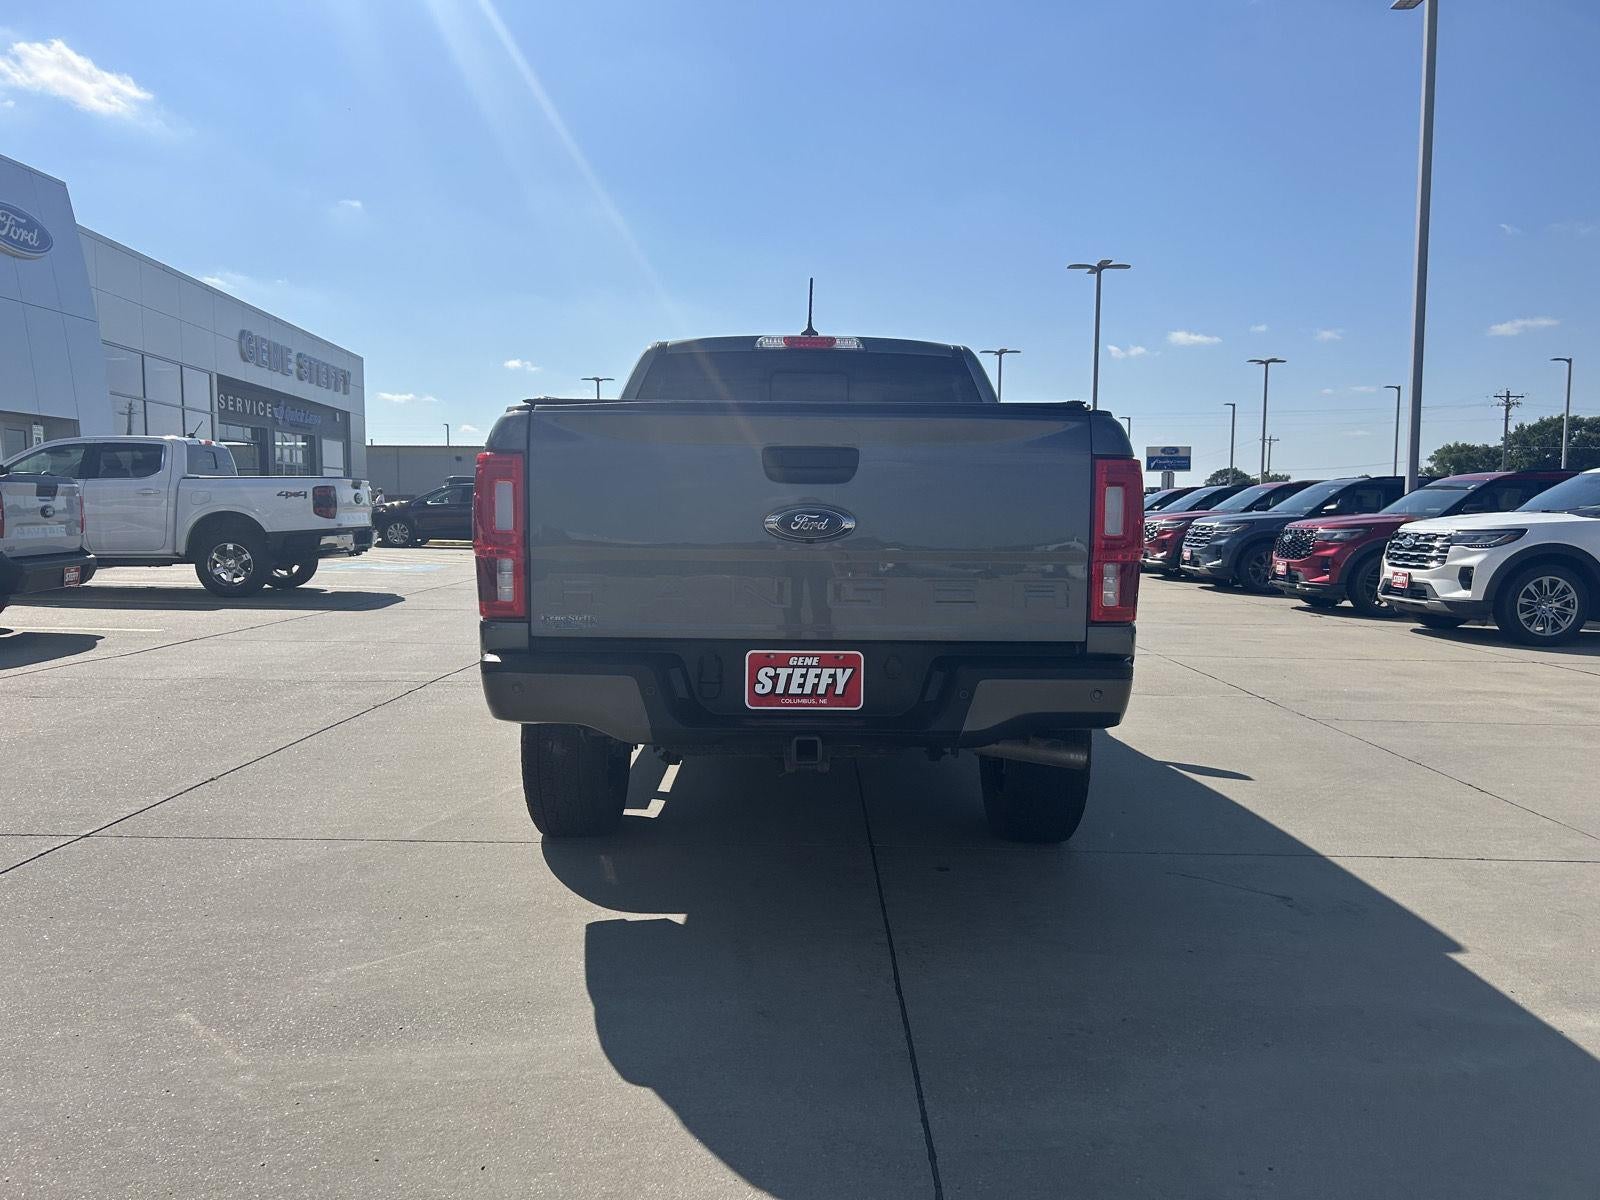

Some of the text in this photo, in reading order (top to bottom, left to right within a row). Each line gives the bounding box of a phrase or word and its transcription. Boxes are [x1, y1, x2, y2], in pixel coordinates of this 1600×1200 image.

[0, 210, 40, 247] Ford
[238, 329, 351, 395] GENE STEFFY
[218, 393, 273, 418] SERVICE
[790, 513, 829, 530] Ford
[788, 656, 820, 666] GENE
[754, 667, 854, 695] STEFFY
